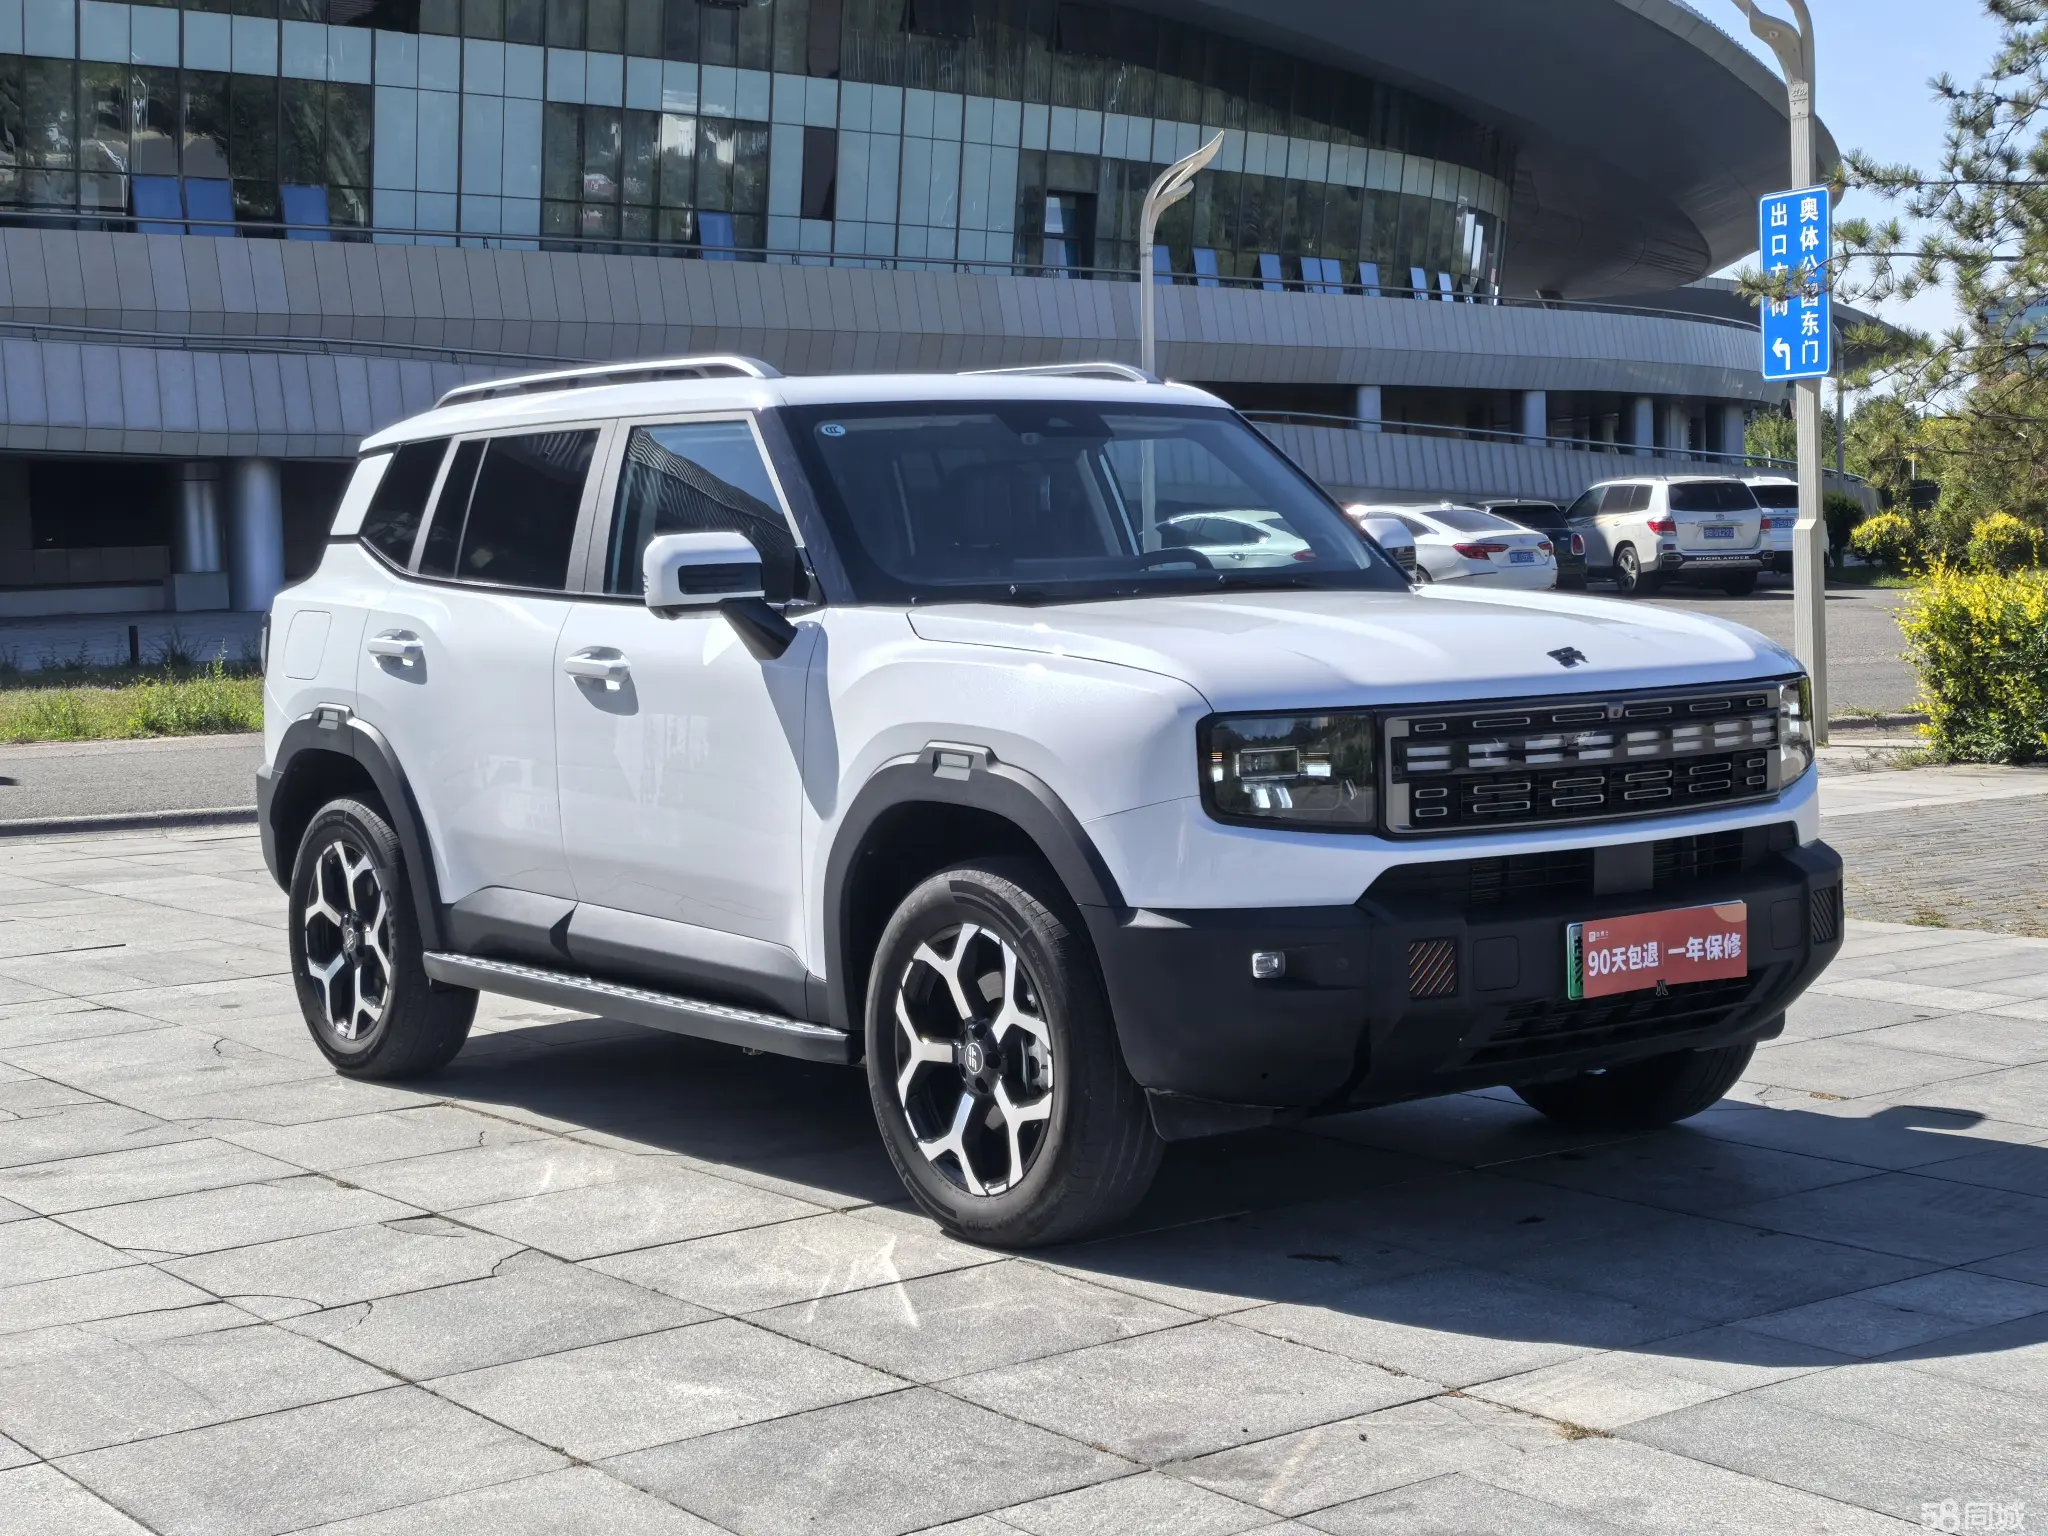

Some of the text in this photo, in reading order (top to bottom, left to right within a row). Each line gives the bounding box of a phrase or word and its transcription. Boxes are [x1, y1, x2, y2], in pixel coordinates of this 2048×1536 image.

[1799, 197, 1819, 365] 奥体公园东门
[1588, 942, 1659, 977] 90天包退
[1668, 933, 1742, 962] 一年保修
